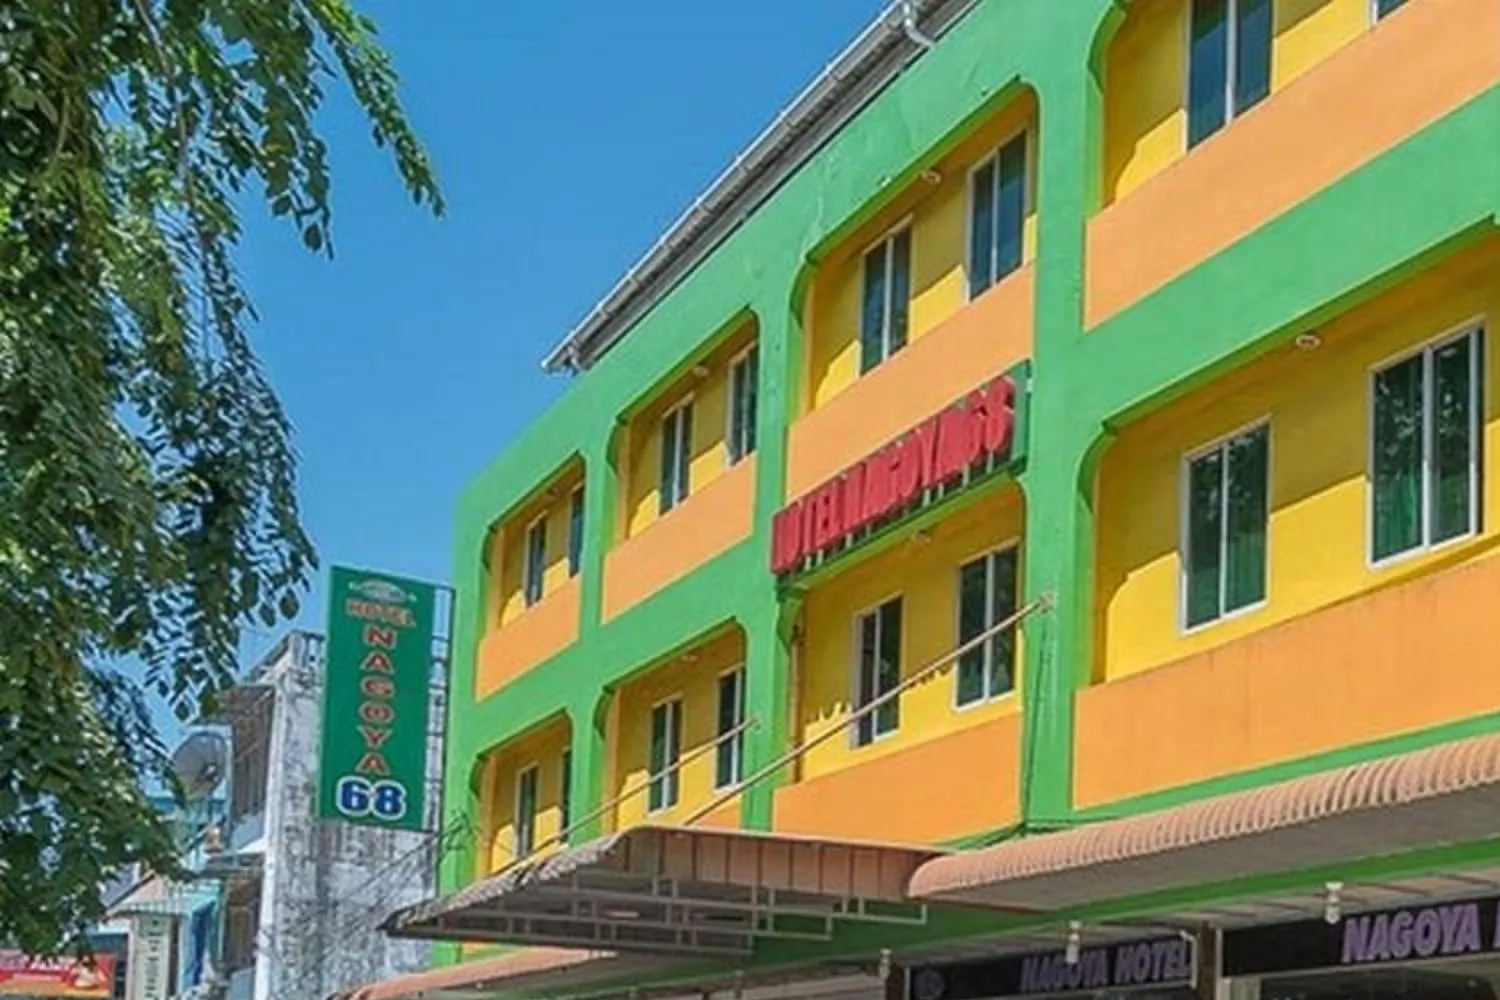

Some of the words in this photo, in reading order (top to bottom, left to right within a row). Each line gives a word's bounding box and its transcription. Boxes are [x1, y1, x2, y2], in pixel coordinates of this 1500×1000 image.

[355, 623, 396, 776] NAGOYA
[335, 774, 407, 821] 68
[1341, 903, 1482, 963] NAGOYA
[1020, 949, 1109, 993] NAGOYA
[1114, 939, 1190, 983] HOTEL
